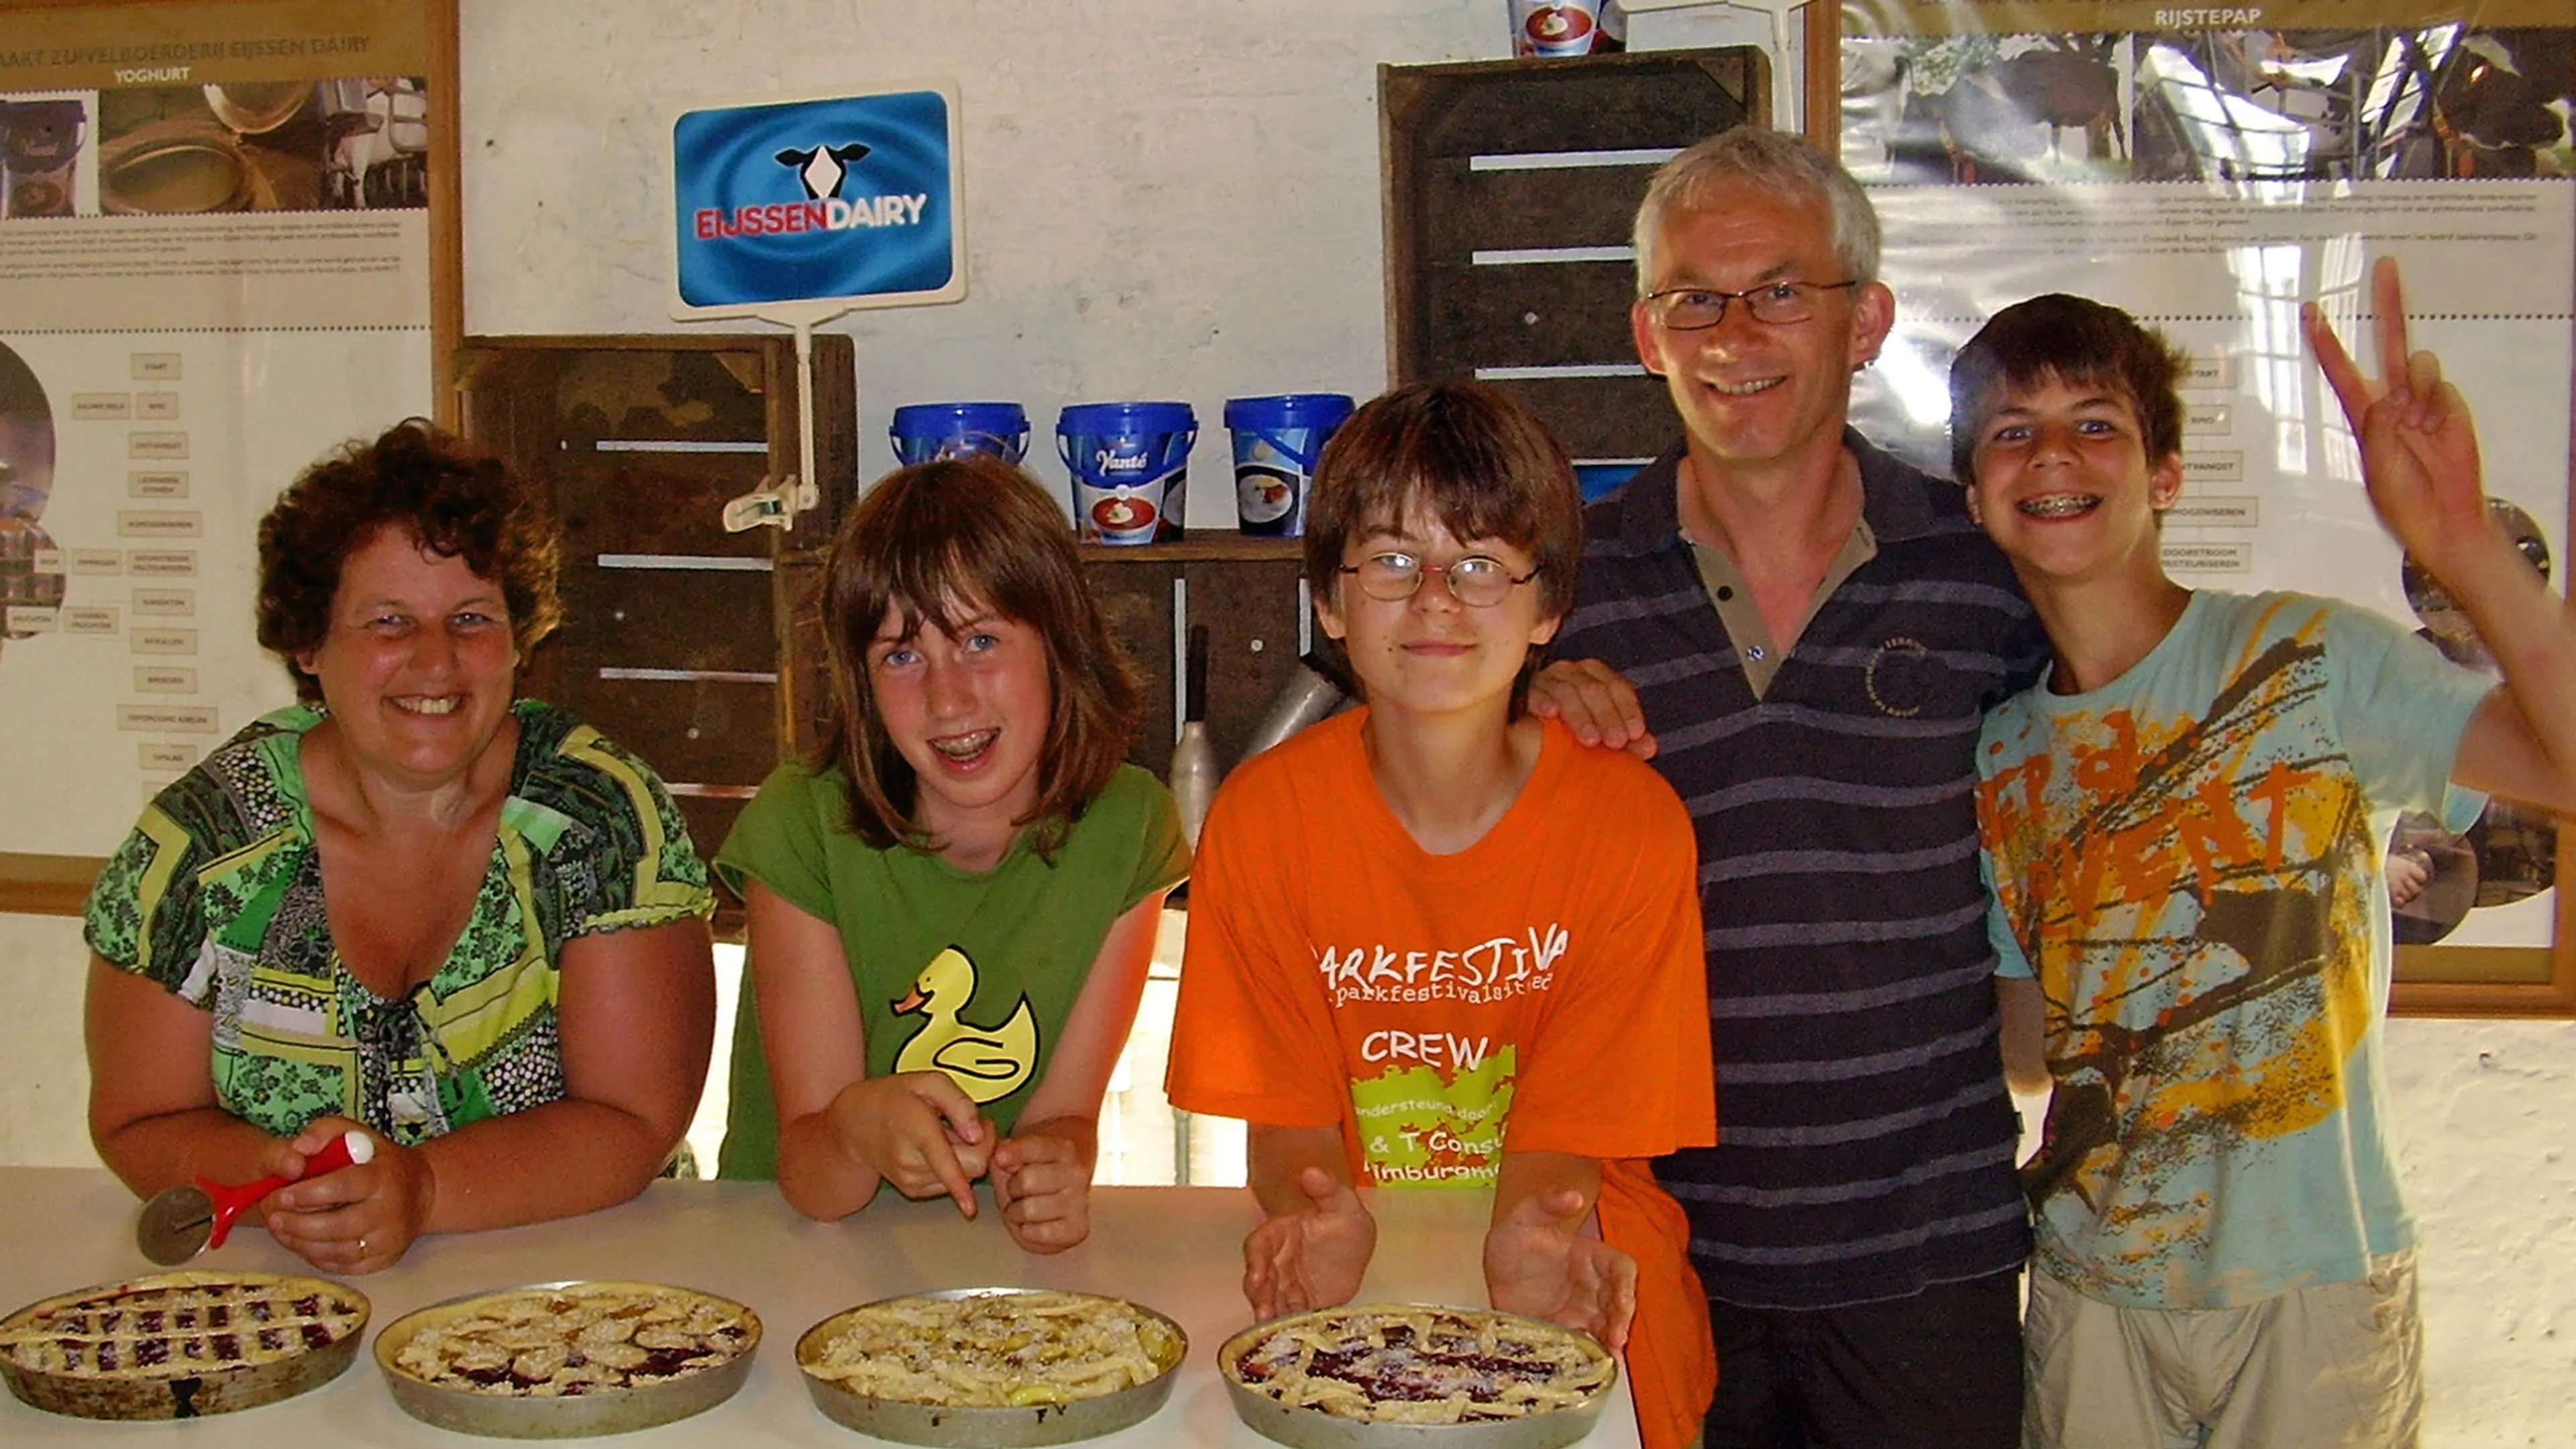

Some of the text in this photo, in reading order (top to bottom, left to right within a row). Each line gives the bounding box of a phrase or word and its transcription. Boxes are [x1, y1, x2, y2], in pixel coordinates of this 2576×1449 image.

[2154, 8, 2261, 28] RIJSTEPAP
[311, 36, 370, 55] DAIRY
[114, 66, 191, 83] YOGHURT
[1095, 449, 1148, 478] Yanté
[1319, 922, 1568, 990] ARKFESTIVA
[1361, 1030, 1489, 1071] CREW
[1399, 1131, 1421, 1152] T
